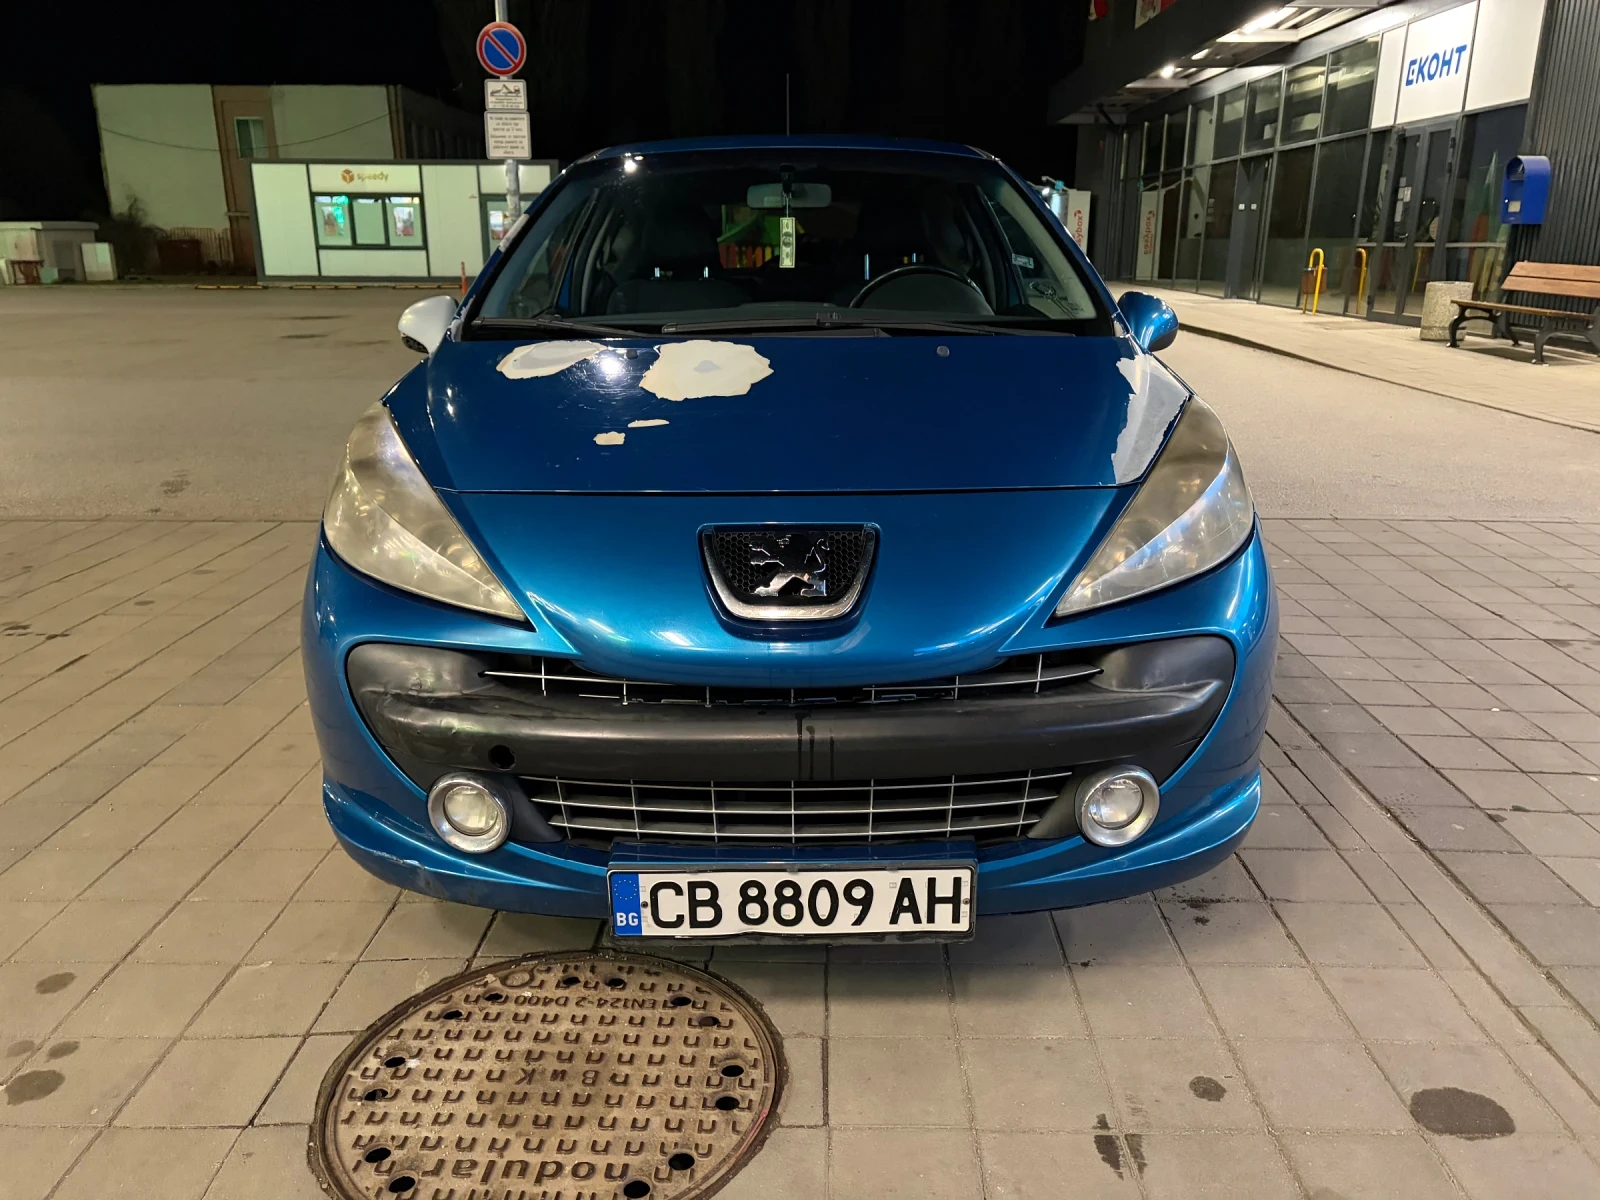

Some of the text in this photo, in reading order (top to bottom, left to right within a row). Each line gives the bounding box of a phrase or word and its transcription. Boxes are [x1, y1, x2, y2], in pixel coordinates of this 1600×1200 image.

[1405, 44, 1468, 86] ЕКОНТ
[357, 171, 388, 182] speedy
[649, 876, 962, 929] CB 8809 AH
[616, 912, 639, 927] BG
[513, 994, 570, 1008] D400
[420, 1158, 630, 1187] nodular
